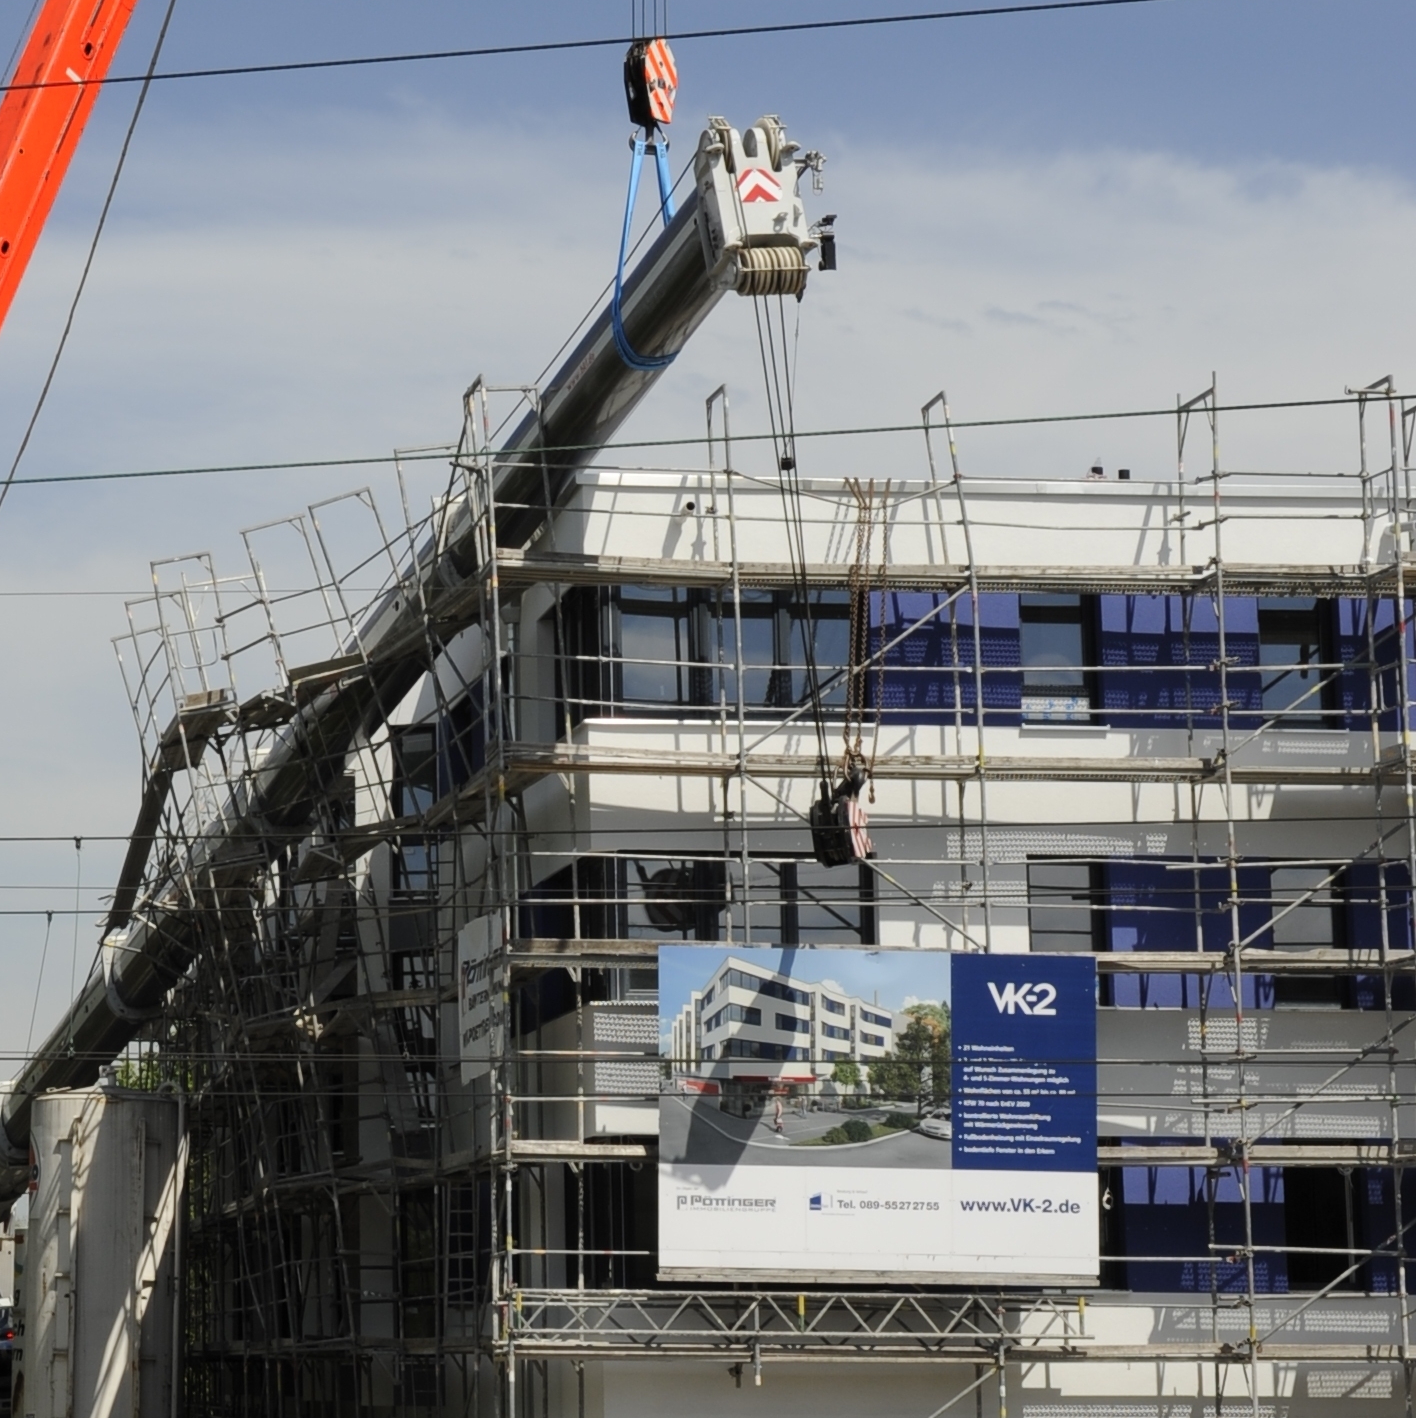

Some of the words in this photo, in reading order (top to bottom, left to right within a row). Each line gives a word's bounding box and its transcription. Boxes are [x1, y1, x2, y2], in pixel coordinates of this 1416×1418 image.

[987, 982, 1057, 1015] VK-2
[837, 1199, 856, 1209] Tel.
[859, 1200, 940, 1211] 089-55272755
[960, 1198, 1081, 1214] www.VK-2.de
